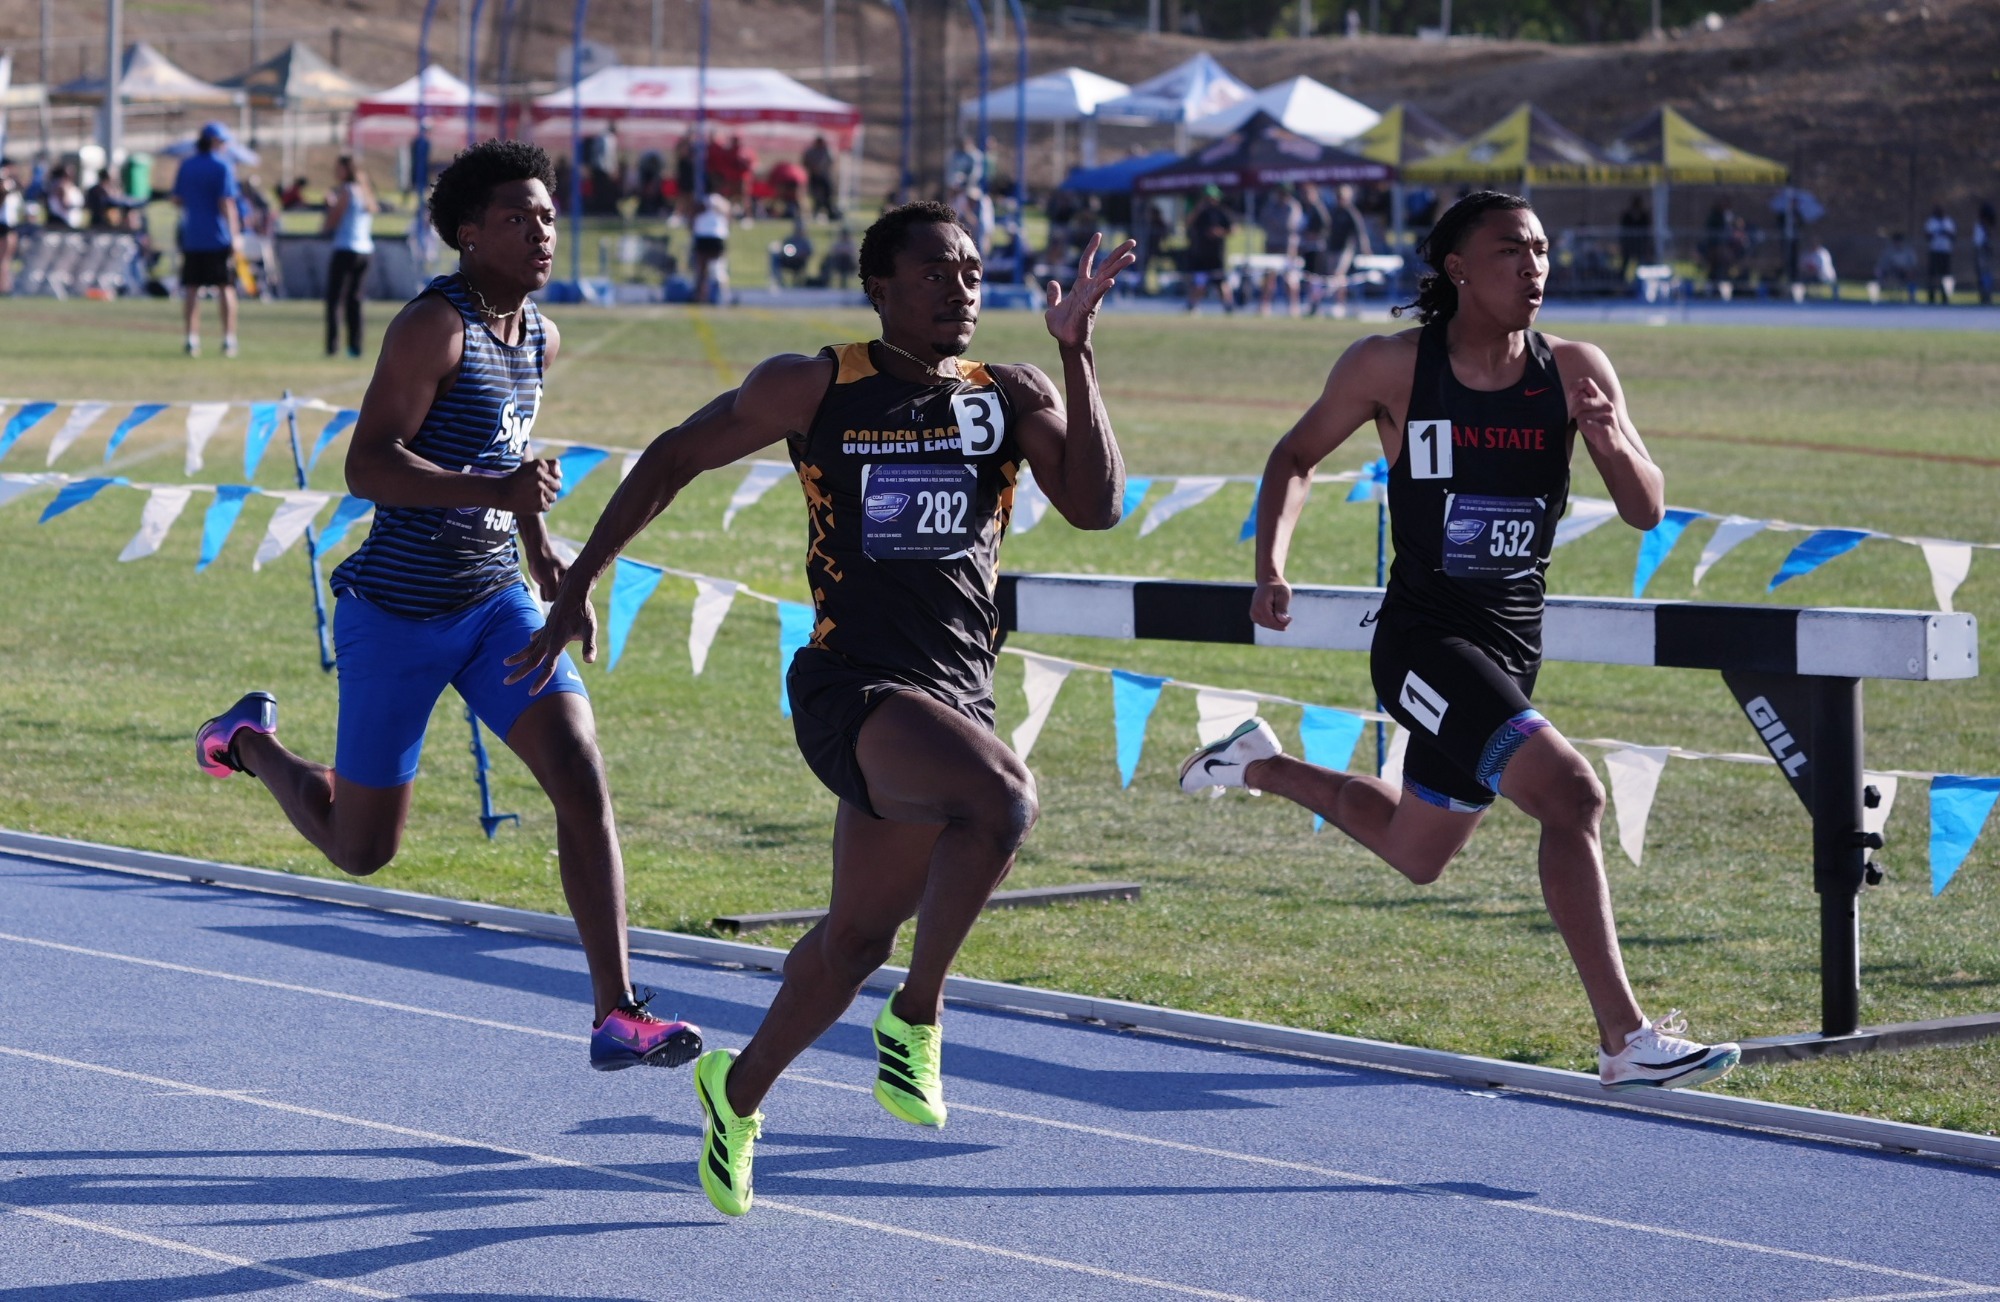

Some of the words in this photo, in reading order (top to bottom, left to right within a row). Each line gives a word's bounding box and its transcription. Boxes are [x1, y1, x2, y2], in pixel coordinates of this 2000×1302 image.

[842, 429, 919, 455] GOLDEN
[922, 425, 963, 452] EAG
[963, 397, 995, 452] 3
[1452, 426, 1479, 448] AN
[1485, 427, 1545, 450] STATE
[1420, 424, 1438, 475] 1
[916, 491, 968, 534] 282
[1490, 520, 1535, 557] 532
[1406, 683, 1441, 719] 1
[1745, 696, 1808, 777] GILL
